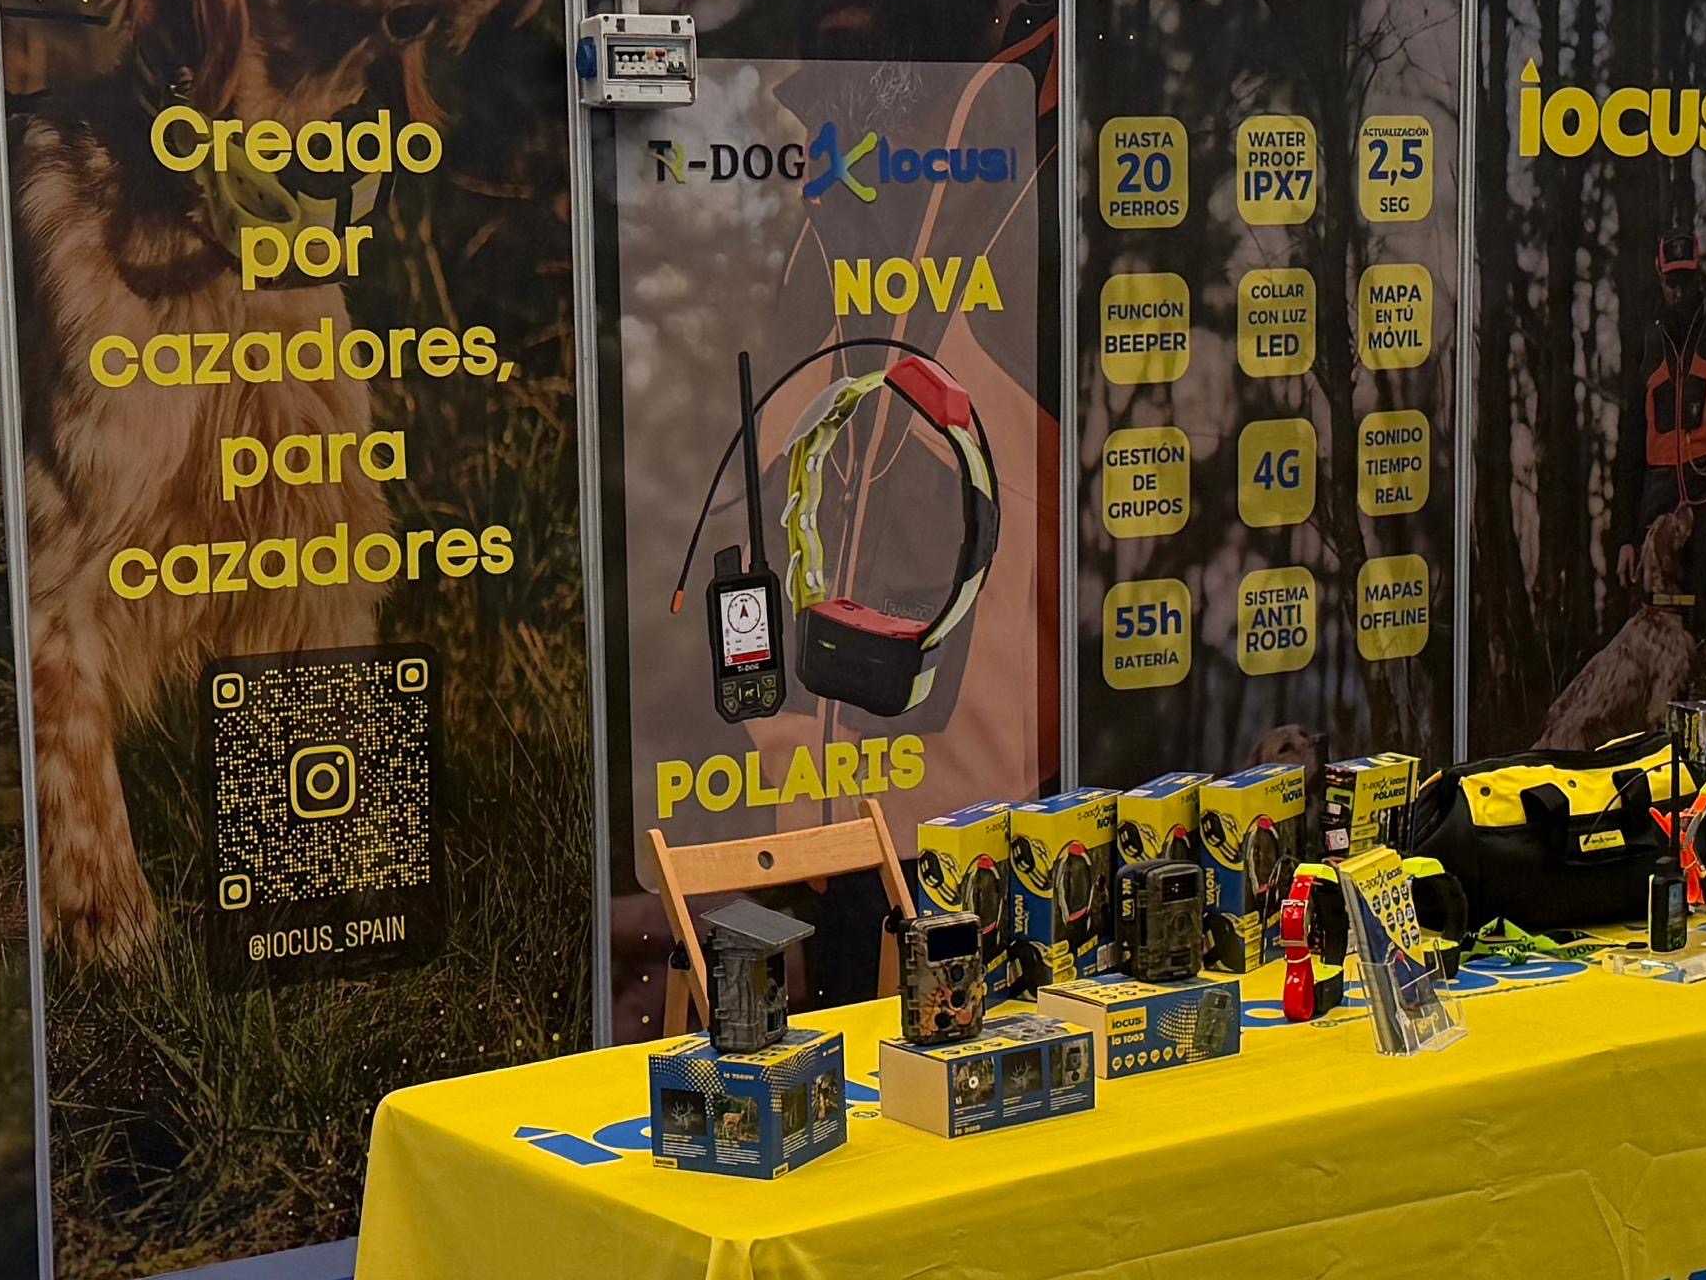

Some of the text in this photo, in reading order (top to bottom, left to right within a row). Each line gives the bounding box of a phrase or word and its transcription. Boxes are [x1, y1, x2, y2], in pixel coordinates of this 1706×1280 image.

[150, 104, 443, 175] Creado
[1114, 131, 1174, 149] HASTA
[1247, 131, 1306, 148] WATER
[1247, 151, 1306, 167] PROOF
[1368, 139, 1425, 187] 2,5
[1116, 152, 1172, 195] 20
[1244, 169, 1314, 202] IPX7
[1109, 200, 1180, 218] PERROS
[1379, 196, 1411, 213] SEG
[239, 220, 374, 292] por
[832, 255, 1004, 317] NOVA
[1250, 284, 1305, 300] COLLAR
[1369, 284, 1423, 304] MAPA
[1107, 299, 1185, 322] FUNCIÓN
[1247, 308, 1307, 325] CON LUZ
[1375, 308, 1393, 323] EN
[1104, 331, 1188, 355] BEEPER
[1255, 333, 1300, 359] LED
[1368, 326, 1424, 351] MÓVIL
[88, 317, 515, 389] cazadores,
[1364, 426, 1424, 447] SONIDO
[219, 430, 408, 501] para
[1105, 442, 1186, 468] GESTIÓN
[1365, 455, 1423, 476] TIEMPO
[1252, 449, 1300, 491] 4G
[1132, 474, 1157, 492] DE
[1375, 486, 1413, 505] REAL
[1108, 497, 1184, 520] GRUPOS
[108, 522, 515, 601] cazadores
[1244, 585, 1310, 607] SISTEMA
[1364, 580, 1424, 603] MAPAS
[1114, 601, 1183, 640] 55h
[1251, 604, 1303, 631] ANTI
[1359, 607, 1427, 631] OFFLINE
[1245, 626, 1308, 653] ROBO
[1114, 647, 1180, 670] BATERÍA
[656, 734, 927, 820] POLARIS
[248, 914, 407, 962] @IOCUS_SPAIN
